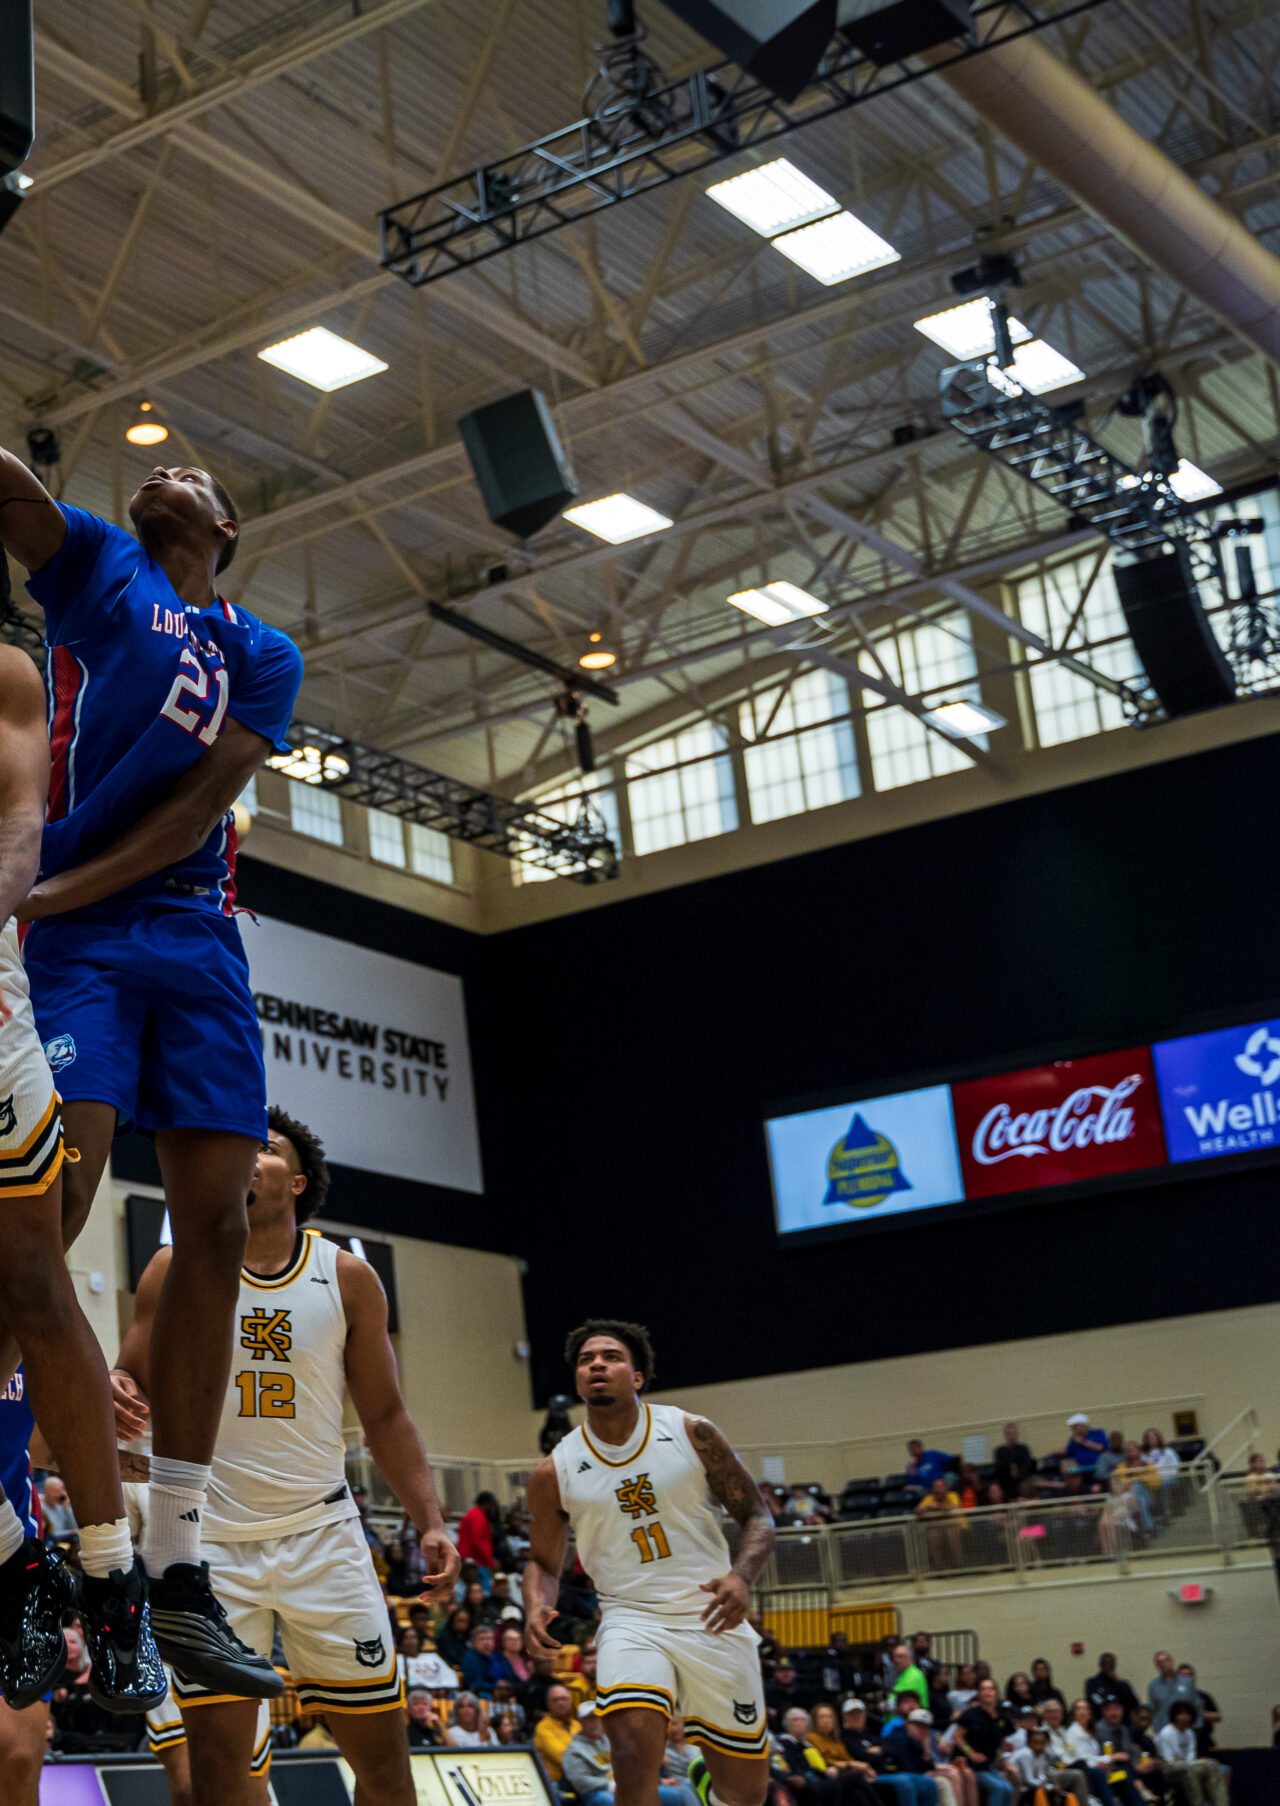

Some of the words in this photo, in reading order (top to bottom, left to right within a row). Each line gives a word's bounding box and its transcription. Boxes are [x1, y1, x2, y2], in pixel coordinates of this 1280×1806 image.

[159, 646, 230, 747] 21
[257, 1027, 449, 1102] NIVERSITY
[382, 1028, 448, 1070] STATE
[235, 1370, 296, 1419] 12
[630, 1521, 672, 1564] 11
